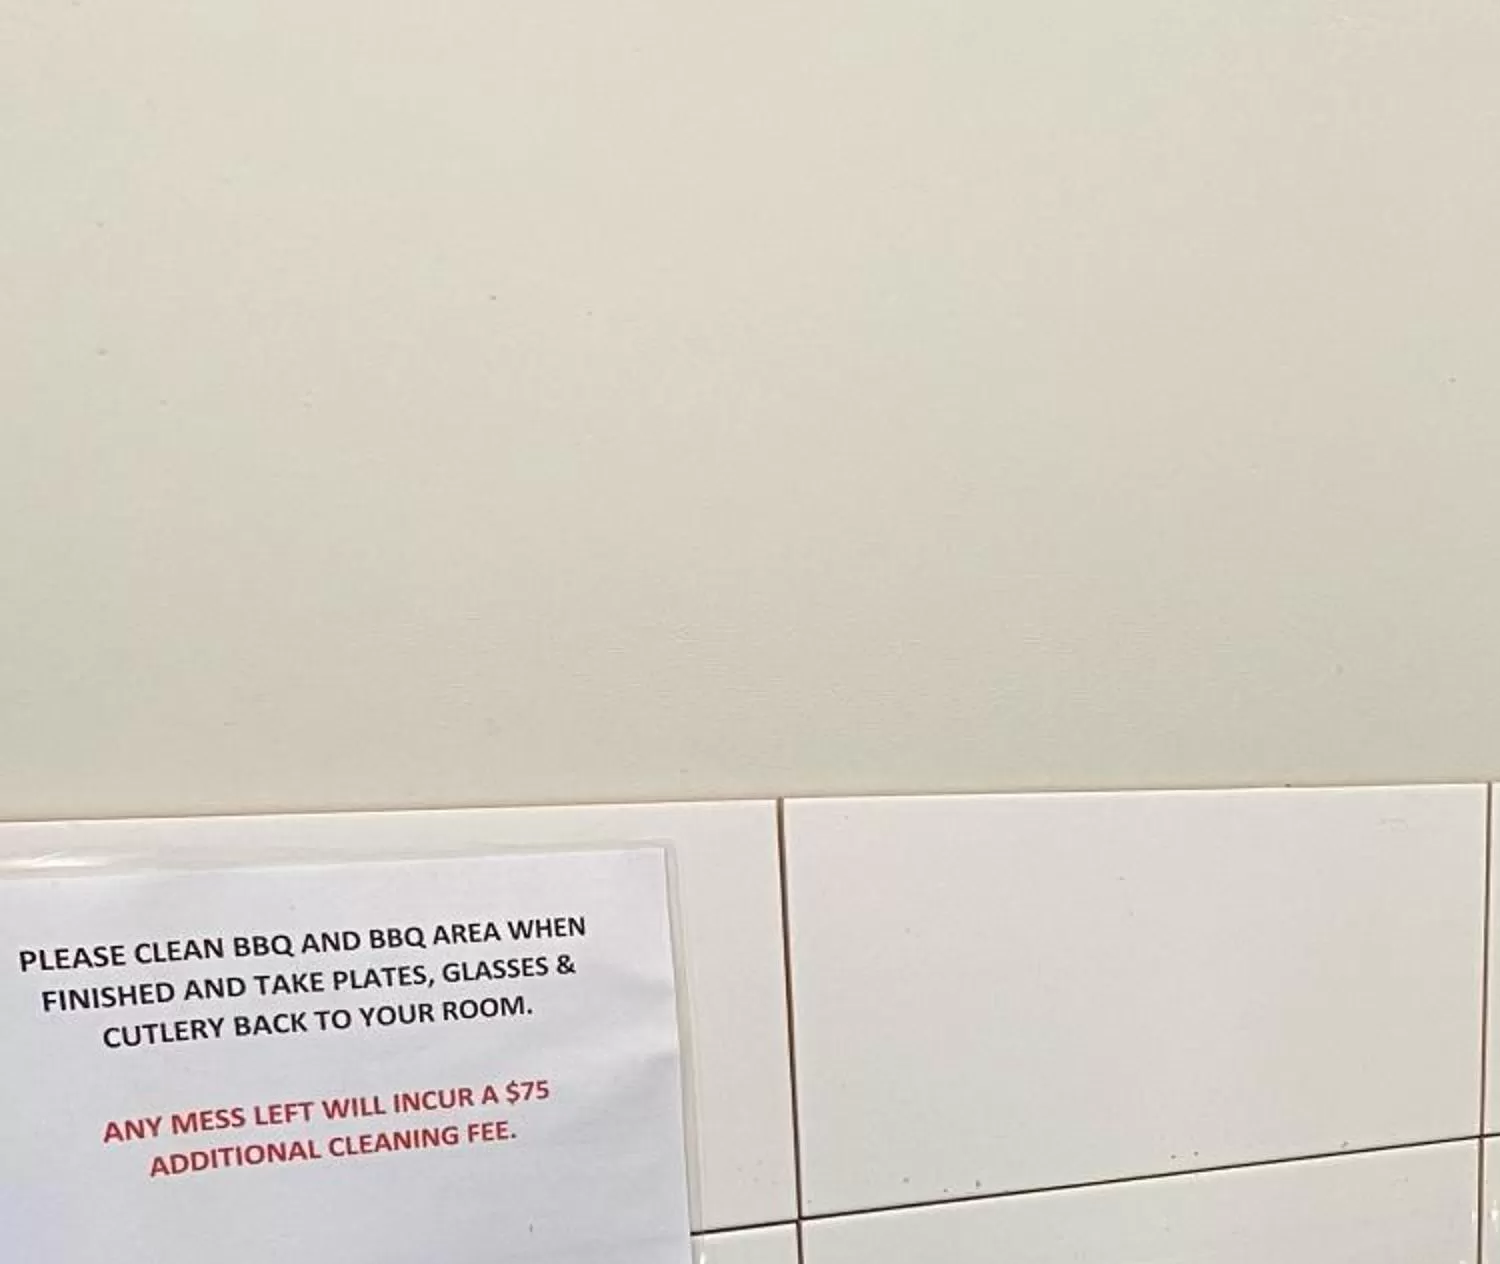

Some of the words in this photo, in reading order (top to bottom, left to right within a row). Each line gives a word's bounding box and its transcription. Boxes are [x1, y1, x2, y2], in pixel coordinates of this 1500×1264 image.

[18, 944, 127, 973] PLEASE
[133, 937, 225, 965] CLEAN
[232, 934, 296, 958] BBQ
[300, 930, 362, 955] AND
[368, 926, 428, 950] BBQ
[432, 921, 503, 946] AREA
[506, 915, 586, 941] WHEN
[41, 981, 176, 1013] FINISHED
[183, 976, 247, 1002] AND
[252, 971, 326, 997] TAKE
[332, 964, 436, 992] PLATES,
[441, 955, 550, 983] GLASSES
[555, 953, 577, 975] &
[102, 1016, 225, 1049] CUTLERY
[233, 1011, 309, 1037] BACK
[312, 1008, 353, 1032] TO
[357, 1002, 436, 1028] YOUR
[441, 995, 533, 1022] ROOM.
[103, 1115, 163, 1144] ANY
[171, 1106, 247, 1136] MESS
[253, 1101, 316, 1126] LEFT
[321, 1095, 388, 1121] WILL
[393, 1087, 475, 1114] INCUR
[481, 1084, 500, 1105] A
[505, 1079, 550, 1106] $75
[149, 1139, 323, 1179] ADDITIONAL
[327, 1125, 460, 1158] CLEANING
[467, 1120, 517, 1144] FEE.
